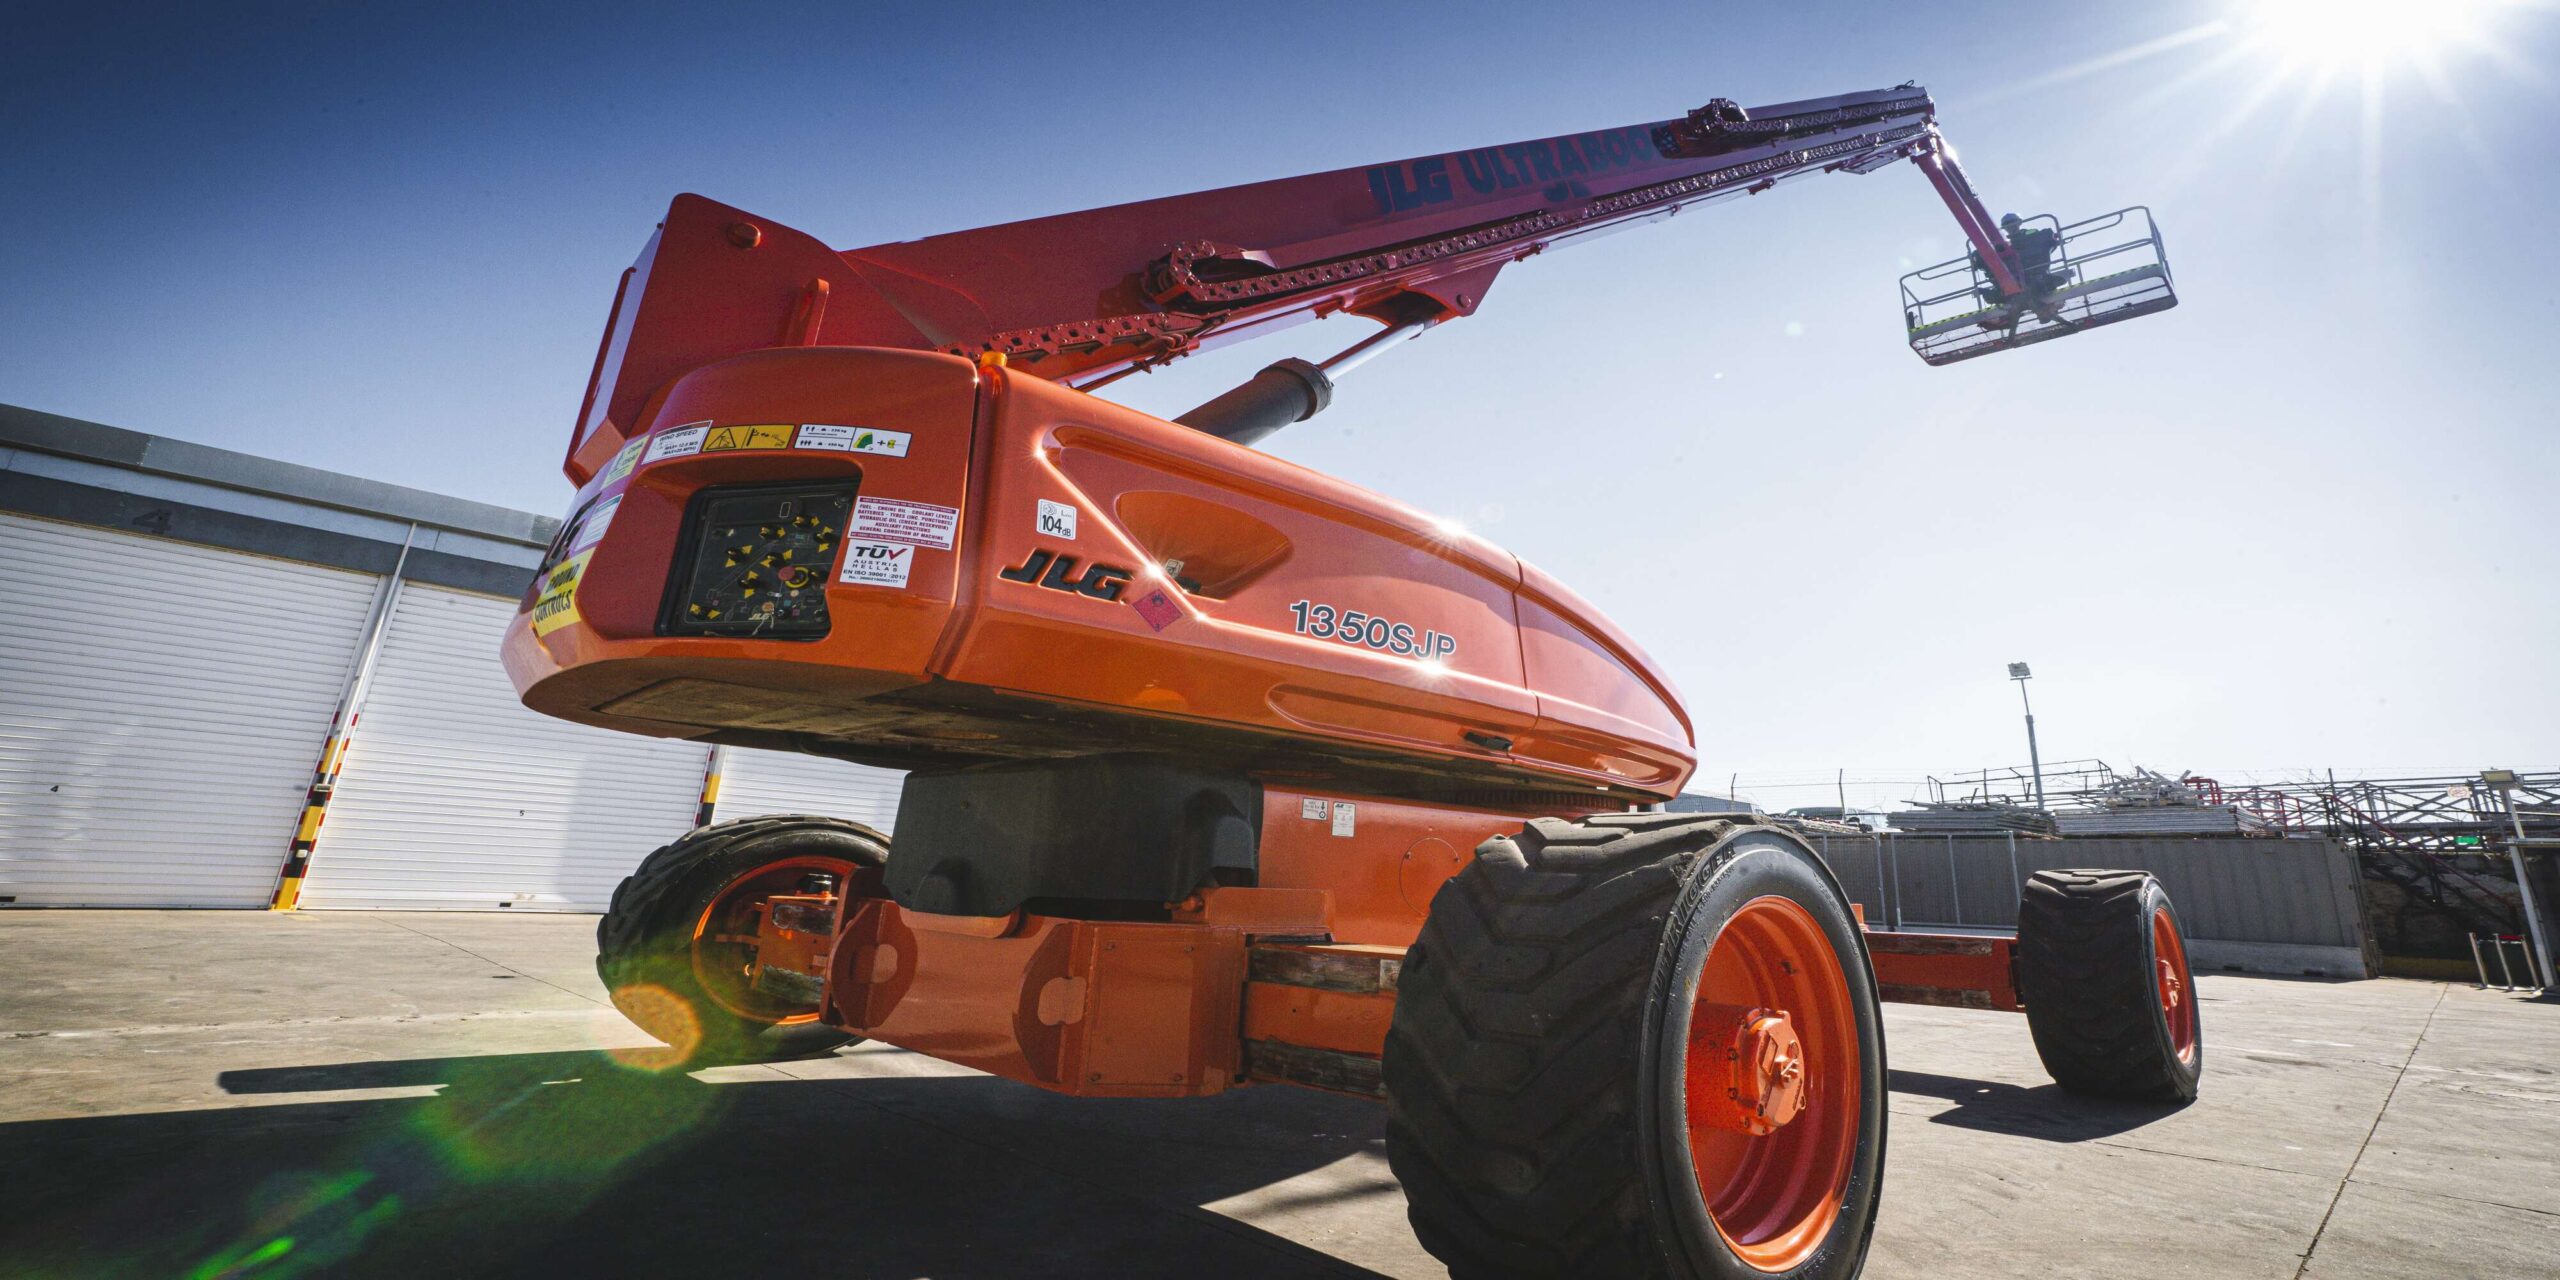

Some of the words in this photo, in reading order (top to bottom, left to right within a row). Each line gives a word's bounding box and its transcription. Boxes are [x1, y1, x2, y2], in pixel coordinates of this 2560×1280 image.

[1456, 124, 1676, 196] ULTRABOO
[675, 429, 698, 438] SPEED
[911, 509, 934, 517] COOLANT
[935, 512, 953, 520] LEVELS
[902, 525, 931, 533] FUNCTIONS
[1042, 514, 1062, 534] 104
[1061, 528, 1072, 537] dB
[883, 528, 912, 536] CONDITION
[921, 533, 944, 541] MACHINE
[852, 564, 898, 572] HELLAS
[853, 559, 898, 568] AUSTRIA
[998, 548, 1135, 604] JLG
[534, 588, 573, 623] CONTROLS
[1290, 599, 1457, 662] 1350SJP
